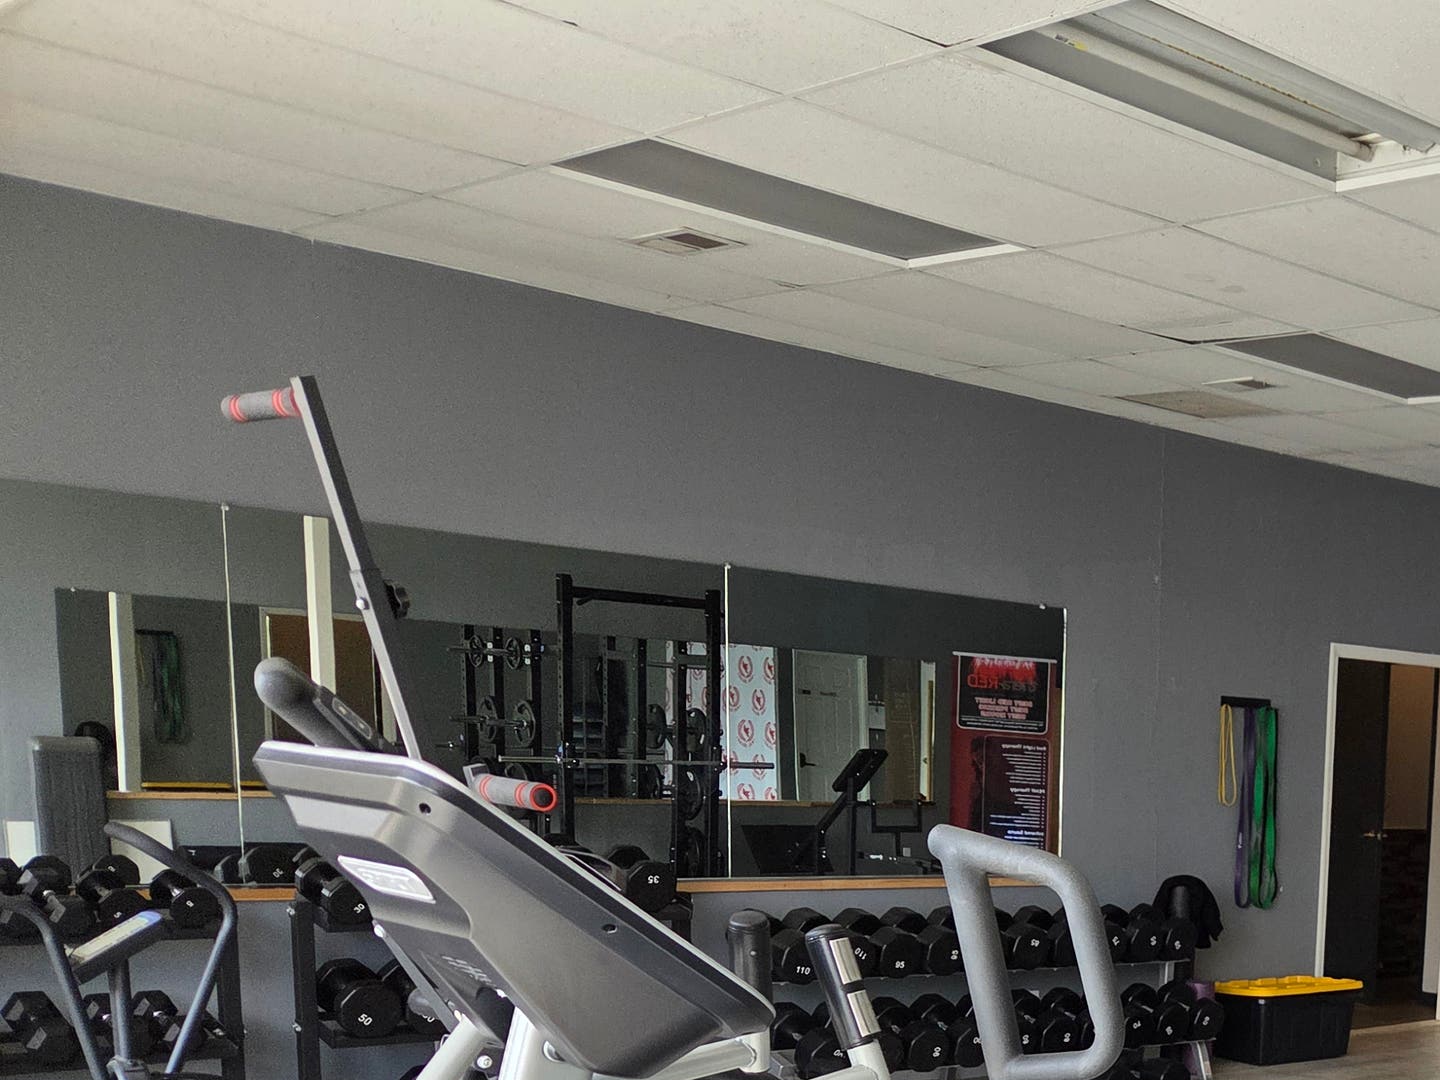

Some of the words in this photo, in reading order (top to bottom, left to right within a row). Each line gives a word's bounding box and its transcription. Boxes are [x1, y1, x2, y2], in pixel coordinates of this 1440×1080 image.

[353, 903, 366, 915] 30
[796, 965, 811, 975] 110
[894, 960, 905, 969] 95
[357, 1013, 373, 1026] 50
